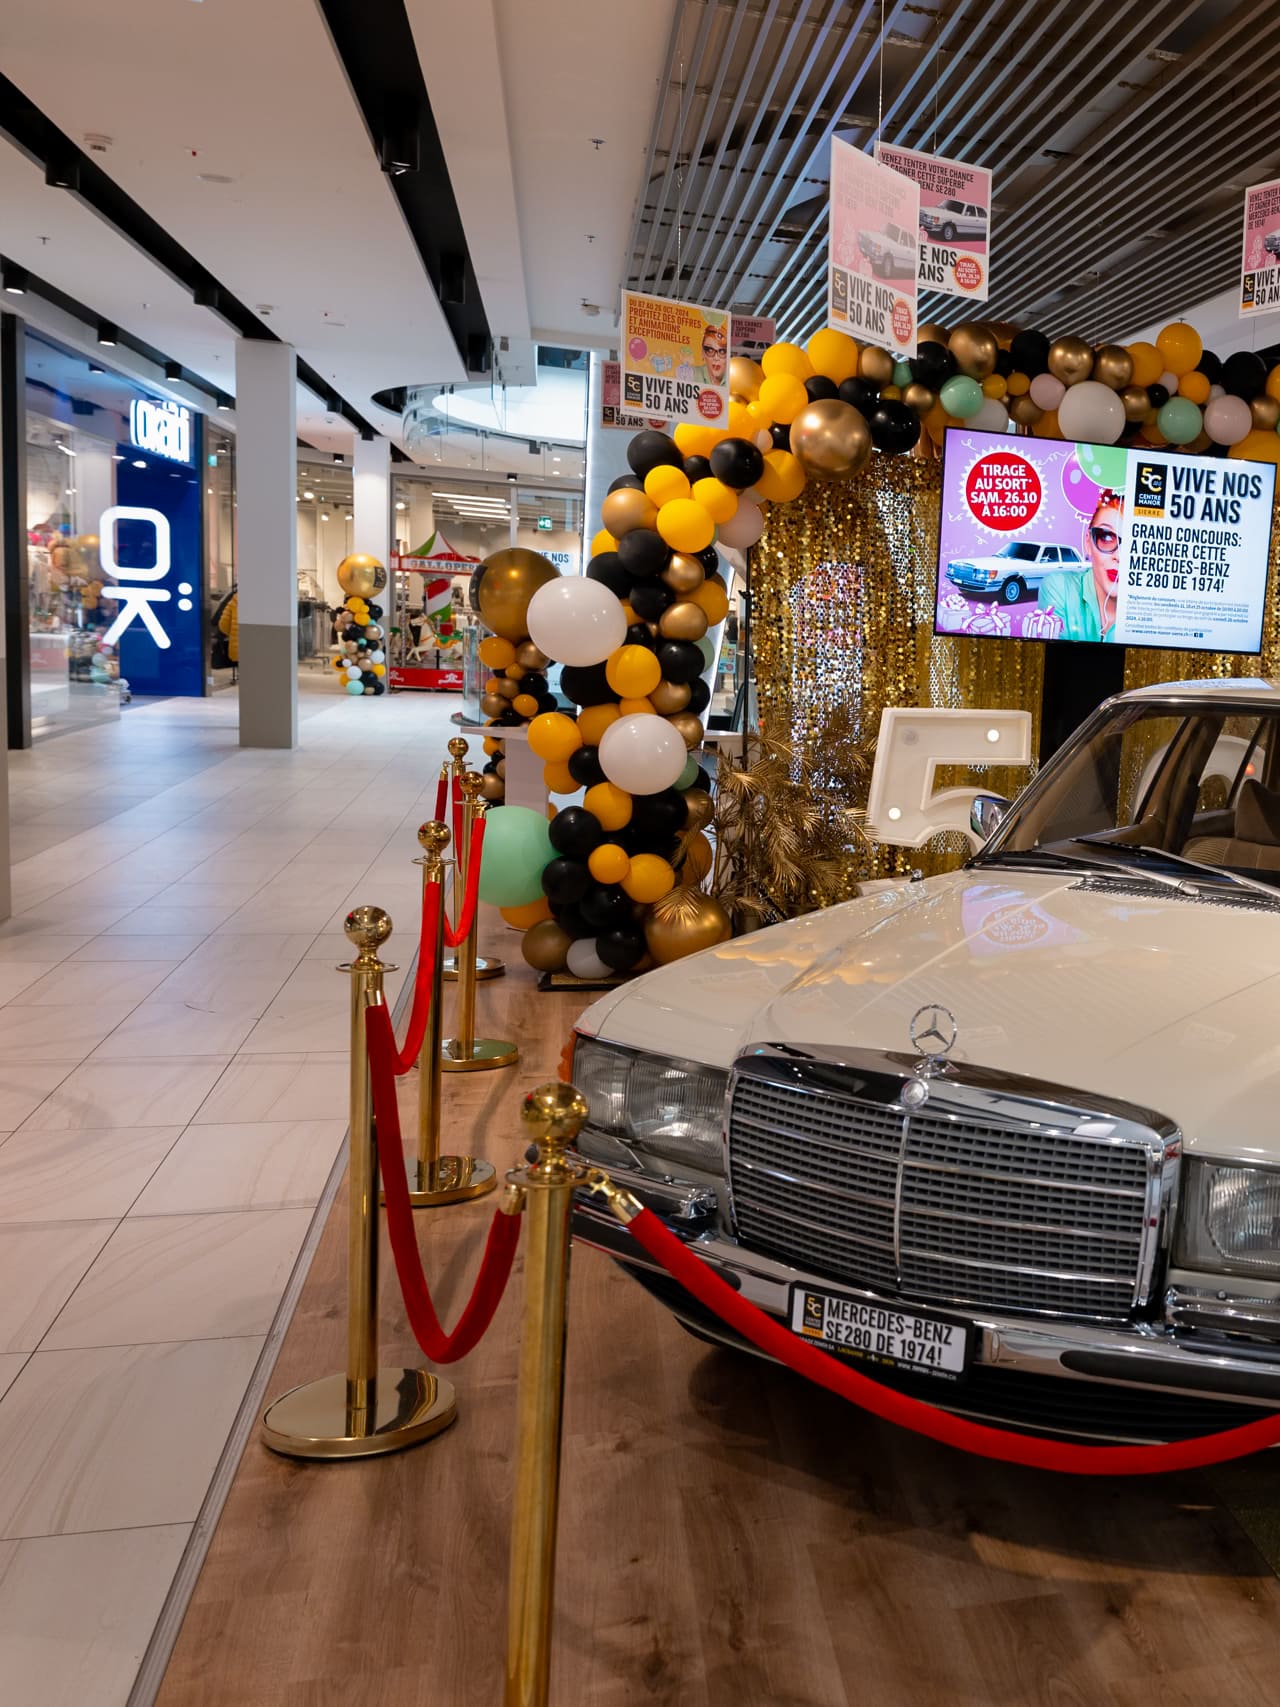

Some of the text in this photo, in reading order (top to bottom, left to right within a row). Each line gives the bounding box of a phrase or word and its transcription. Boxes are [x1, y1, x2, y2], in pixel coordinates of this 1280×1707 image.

[881, 152, 974, 183] VENEZ TENTER VOTRE CHANCE
[937, 174, 966, 190] SUPERBE
[931, 246, 957, 267] NOS
[918, 264, 944, 283] ANS
[1257, 269, 1275, 288] VIVE
[849, 274, 894, 314] VIVE NOS
[1255, 288, 1266, 306] 50
[629, 306, 661, 320] PROFITEZ
[662, 313, 676, 324] DES
[677, 316, 702, 329] OFFRES
[639, 319, 681, 334] ANIMATIONS
[849, 302, 861, 325] 50
[865, 310, 885, 335] ANS
[629, 326, 690, 345] EXCEPTIONNELLES
[646, 377, 700, 400] VIVE NOS
[646, 394, 660, 410] 50
[664, 398, 689, 414] ANS
[981, 464, 1026, 476] TIRAGE
[975, 478, 992, 490] AU
[1172, 466, 1263, 499] VIVE NOS
[971, 492, 1037, 503] SAM. 26.10
[993, 506, 1027, 517] 16:00
[1170, 494, 1241, 524] 50 ANS
[1132, 523, 1242, 547] GRAND CONCOURS:
[551, 552, 569, 563] NOS
[1142, 540, 1189, 558] GAGNER
[1192, 546, 1227, 561] CETTE
[1129, 556, 1230, 577] MERCEDES-BENZ
[1128, 572, 1224, 592] SE 280 DE 1974!
[827, 1300, 953, 1346] MERCEDES-BENZ
[876, 1334, 894, 1354] DE
[900, 1340, 942, 1366] 1974!
